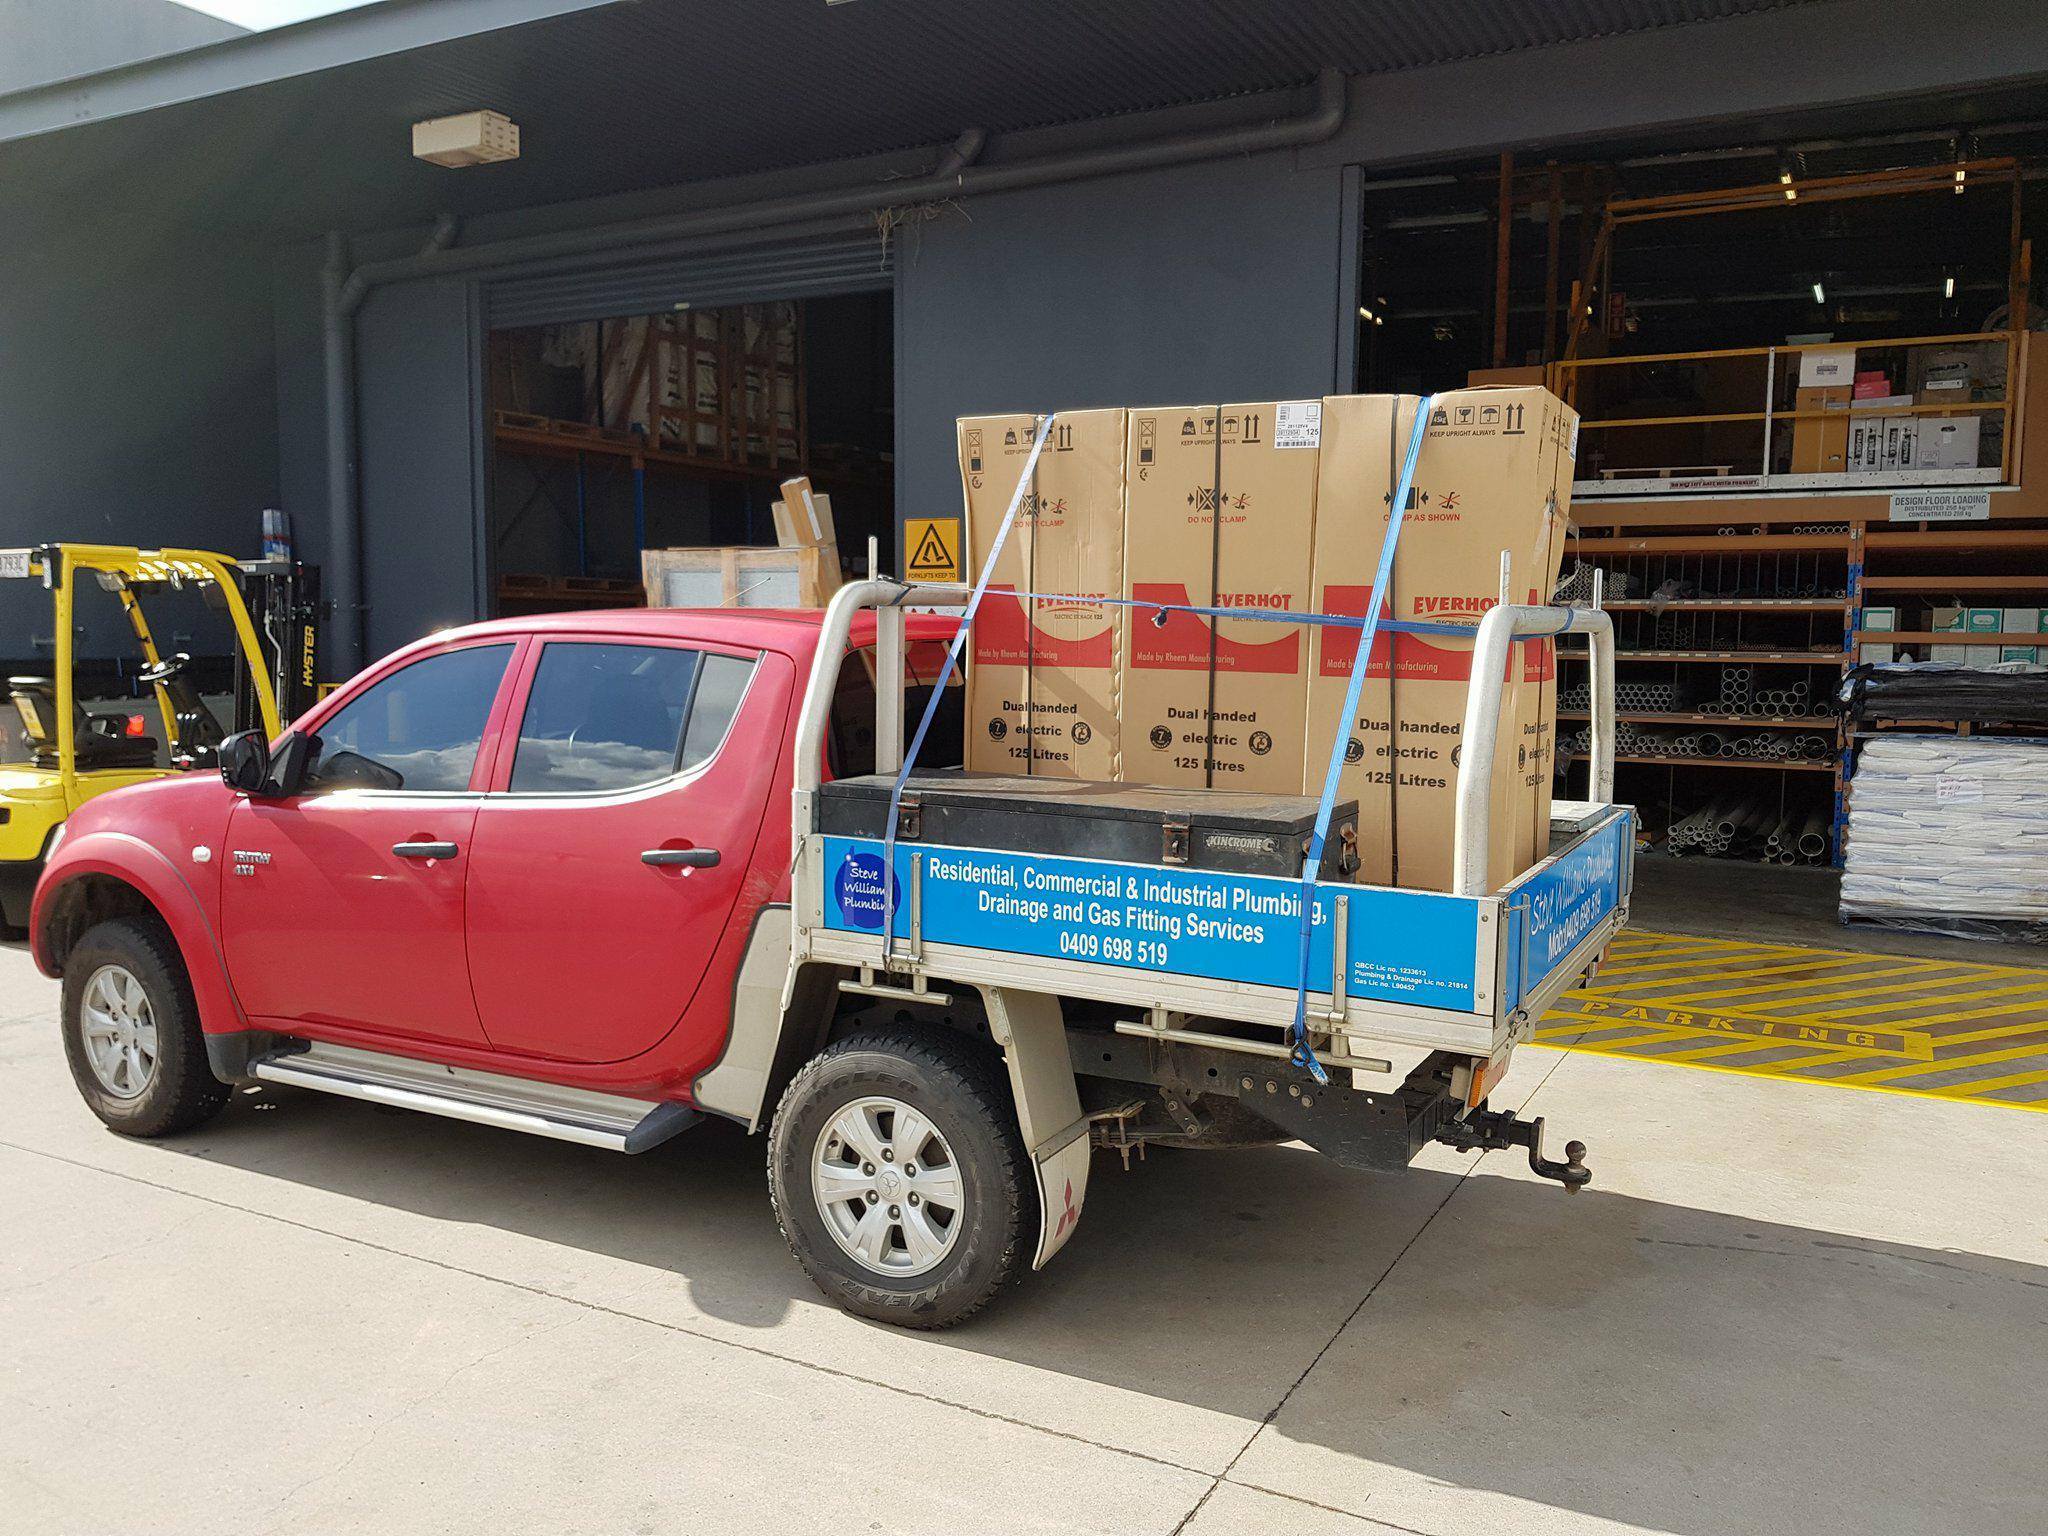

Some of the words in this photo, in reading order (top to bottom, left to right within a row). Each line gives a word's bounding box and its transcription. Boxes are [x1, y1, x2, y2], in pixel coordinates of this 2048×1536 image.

[1306, 428, 1318, 436] 125
[1429, 430, 1445, 438] KEEP
[1895, 497, 1924, 506] DESIGN
[1925, 496, 1950, 505] FLOOR
[1952, 495, 1987, 504] LOADING
[1384, 514, 1412, 522] CMP
[1427, 514, 1460, 522] SHOWN
[1038, 593, 1106, 610] EVERHOT
[1216, 594, 1292, 610] EVERHOT
[303, 624, 314, 687] HYSTER
[978, 649, 992, 658] Made
[1136, 652, 1154, 662] Made
[1156, 652, 1164, 664] by
[1166, 652, 1186, 662] Rheem
[1327, 658, 1346, 669] Made
[1002, 700, 1028, 712] Dual
[1032, 702, 1078, 714] handed
[1168, 708, 1198, 720] Dual
[1360, 718, 1391, 731] Dua
[1400, 720, 1460, 735] handed
[1008, 748, 1030, 759] 125
[1034, 748, 1069, 761] Litres
[1174, 757, 1198, 770] 125
[1365, 770, 1392, 784] 125
[1400, 774, 1446, 788] Litres
[1208, 834, 1262, 849] KINCROME
[850, 868, 878, 880] Steve
[844, 882, 885, 896] William
[930, 858, 1018, 891] Residential,
[1023, 866, 1120, 898] Commercial
[1126, 876, 1138, 900] &
[1144, 879, 1227, 910] Industrial
[978, 890, 1048, 923] Drainage
[1053, 902, 1083, 923] and
[1088, 902, 1120, 928] Gas
[1126, 906, 1181, 940] Fitting
[1186, 913, 1264, 944] Services
[1580, 897, 1591, 932] 698
[1592, 888, 1602, 920] 519
[1060, 931, 1098, 957] 0409
[1102, 936, 1132, 962] 698
[1138, 941, 1168, 966] 519
[1354, 962, 1374, 970] QBCC
[1376, 964, 1386, 972] Lic
[1400, 967, 1426, 976] 1233613
[1354, 970, 1384, 980] Plumbing
[1394, 974, 1422, 984] Drainage
[1424, 978, 1434, 986] Lic
[1368, 978, 1378, 986] Lic
[1582, 1001, 1876, 1047] PARKING
